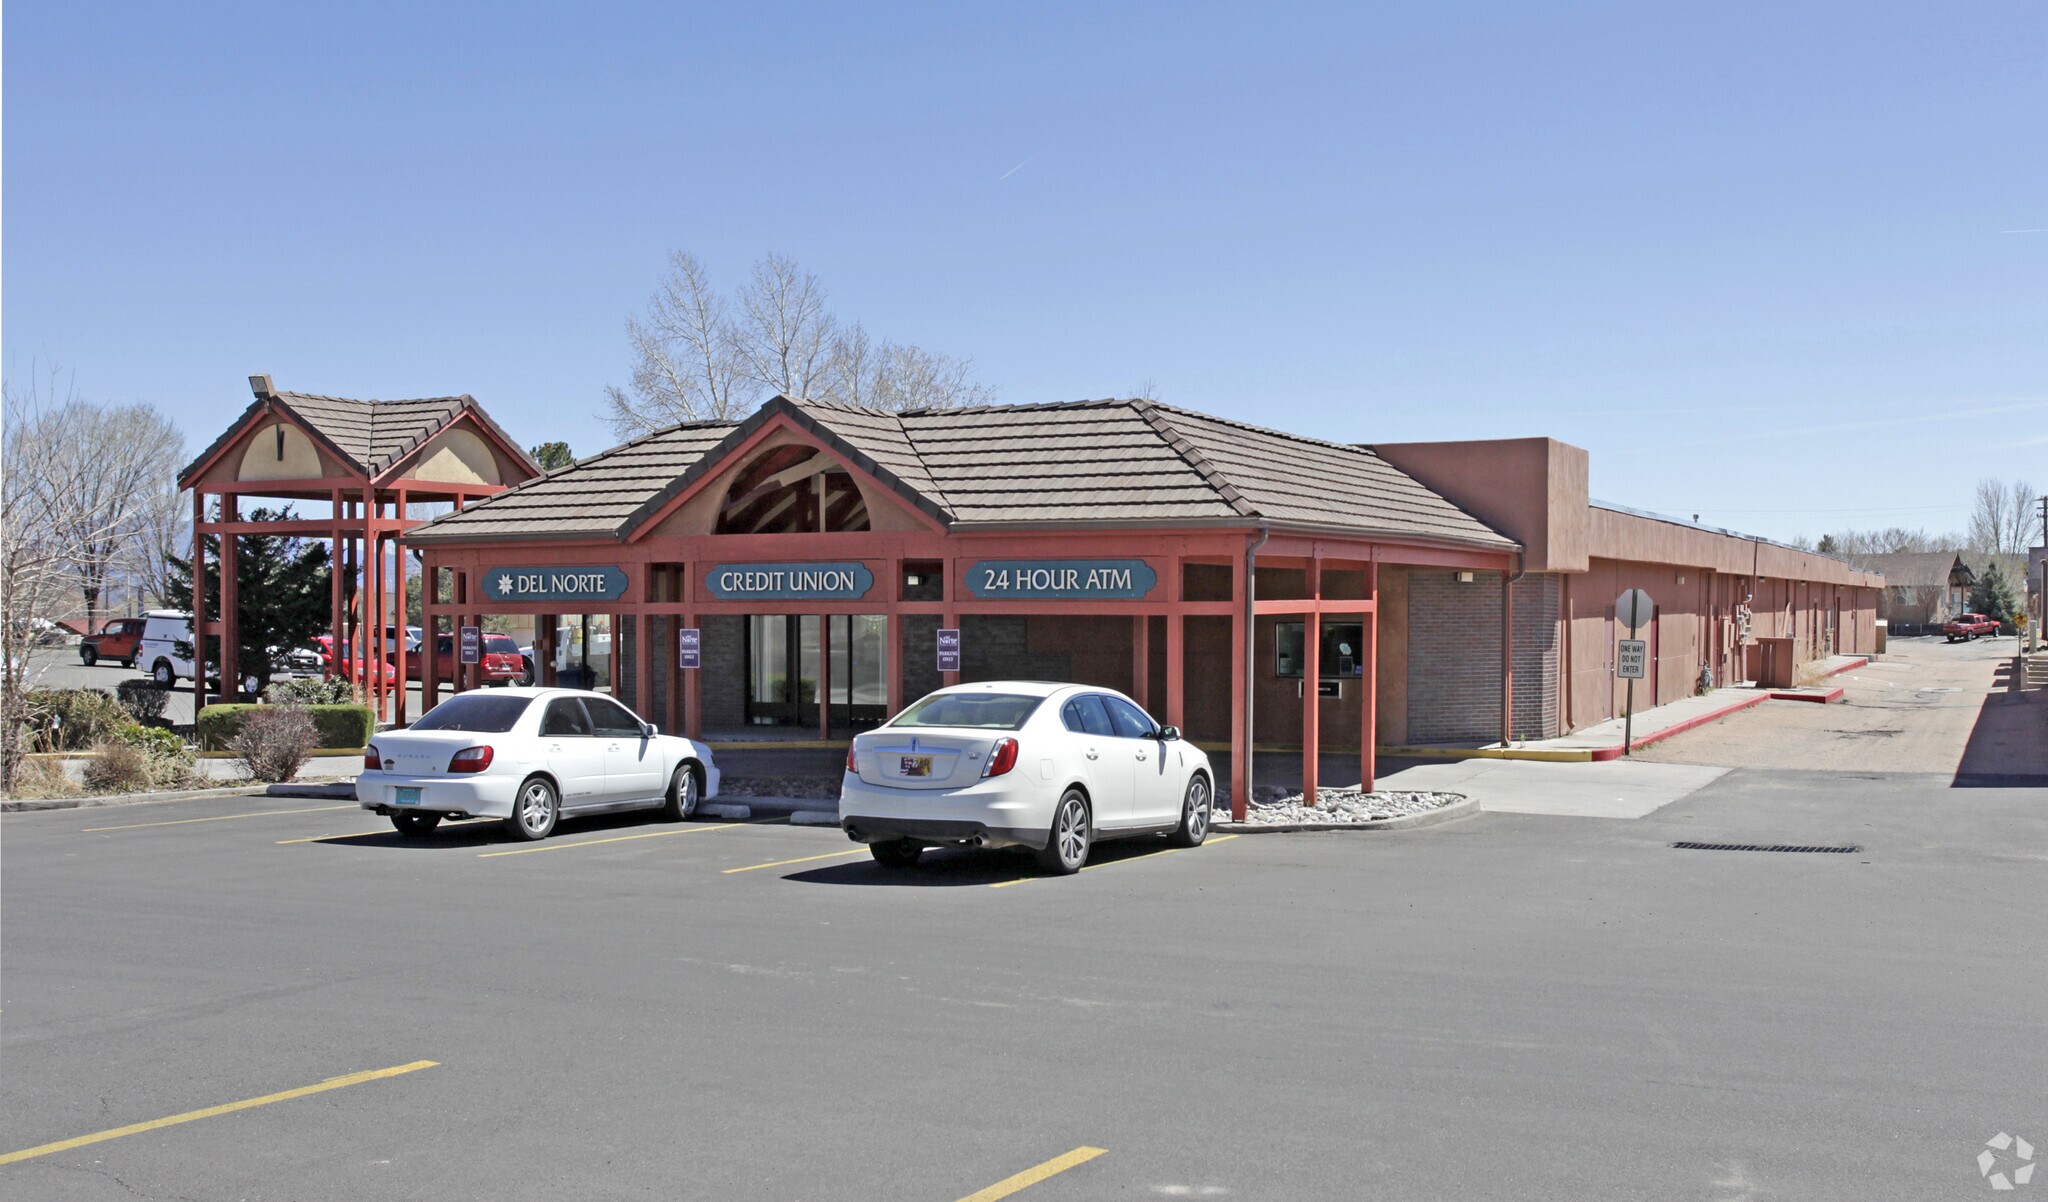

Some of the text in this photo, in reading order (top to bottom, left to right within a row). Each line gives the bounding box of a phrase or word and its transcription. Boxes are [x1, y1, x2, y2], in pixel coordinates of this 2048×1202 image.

[518, 575, 606, 593] DEL NORTE
[721, 571, 855, 592] CREDIT UNION
[984, 569, 1132, 590] 24 HOUR ATM
[1621, 644, 1643, 653] ONE WAY
[1622, 655, 1629, 663] DO
[1622, 665, 1639, 674] ENTER
